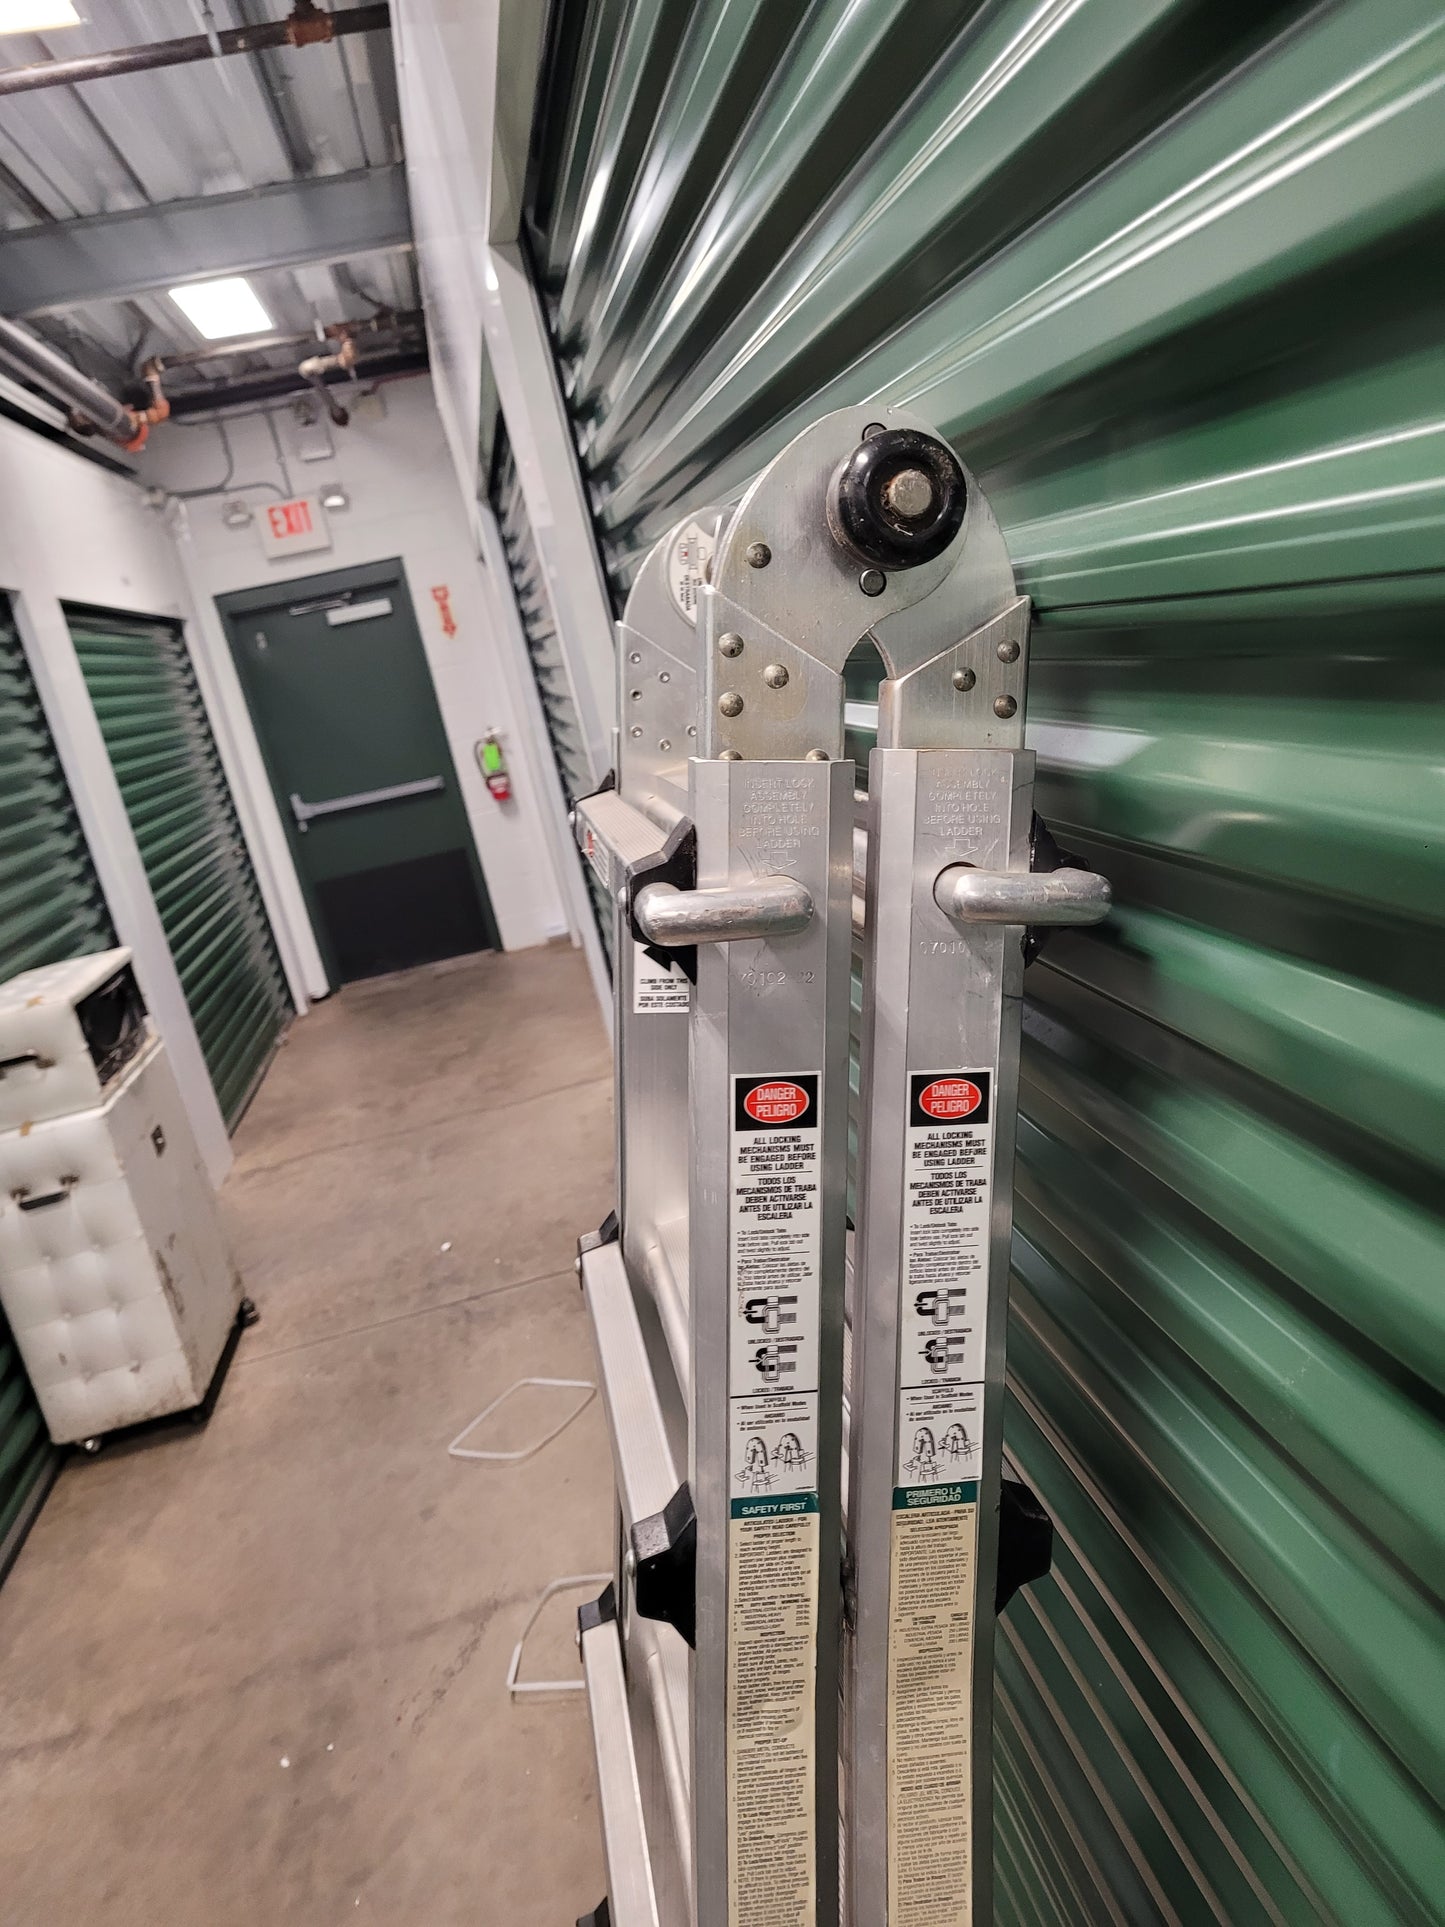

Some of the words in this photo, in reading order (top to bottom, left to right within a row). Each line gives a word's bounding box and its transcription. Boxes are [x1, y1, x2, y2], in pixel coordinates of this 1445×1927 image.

[267, 501, 313, 539] EXIT
[940, 826, 984, 837] LADDER
[756, 1086, 796, 1100] DANGER
[931, 1083, 969, 1096] DANGER
[755, 1103, 797, 1116] PELIGRO
[931, 1099, 969, 1113] PELIGRO
[769, 1135, 801, 1143] LOCKING
[942, 1131, 972, 1139] LOCKING
[740, 1144, 790, 1154] MECHANISMS
[793, 1143, 814, 1151] MUST
[914, 1140, 962, 1149] MECHANISMS
[750, 1154, 784, 1162] ENGAGED
[787, 1152, 816, 1160] BEFORE
[923, 1149, 957, 1157] ENGAGED
[959, 1148, 987, 1156] BEFORE
[750, 1163, 772, 1171] USING
[775, 1162, 804, 1170] LADDER
[923, 1158, 944, 1166] USING
[947, 1157, 974, 1165] LADDER
[931, 1171, 952, 1179] TODOS
[954, 1170, 967, 1178] LOS
[757, 1177, 780, 1185] TODOS
[909, 1180, 953, 1189] MECANISMOS
[965, 1178, 986, 1186] TRABA
[735, 1185, 782, 1194] MECANISMOS
[794, 1183, 816, 1191] TRABA
[941, 1188, 976, 1196] ACTIVARSE
[769, 1193, 806, 1201] ACTIVARSE
[944, 1196, 972, 1205] UTILIZAR
[738, 1204, 761, 1212] ANTES
[772, 1202, 802, 1210] UTILIZAR
[929, 1205, 963, 1214] ESCALERA
[757, 1212, 792, 1220] ESCALERA
[905, 1487, 948, 1498] PRIMERO
[949, 1486, 962, 1494] LA
[906, 1494, 961, 1505] SEGURIDAD
[741, 1503, 778, 1515] SAFETY
[780, 1501, 806, 1511] FIRST
